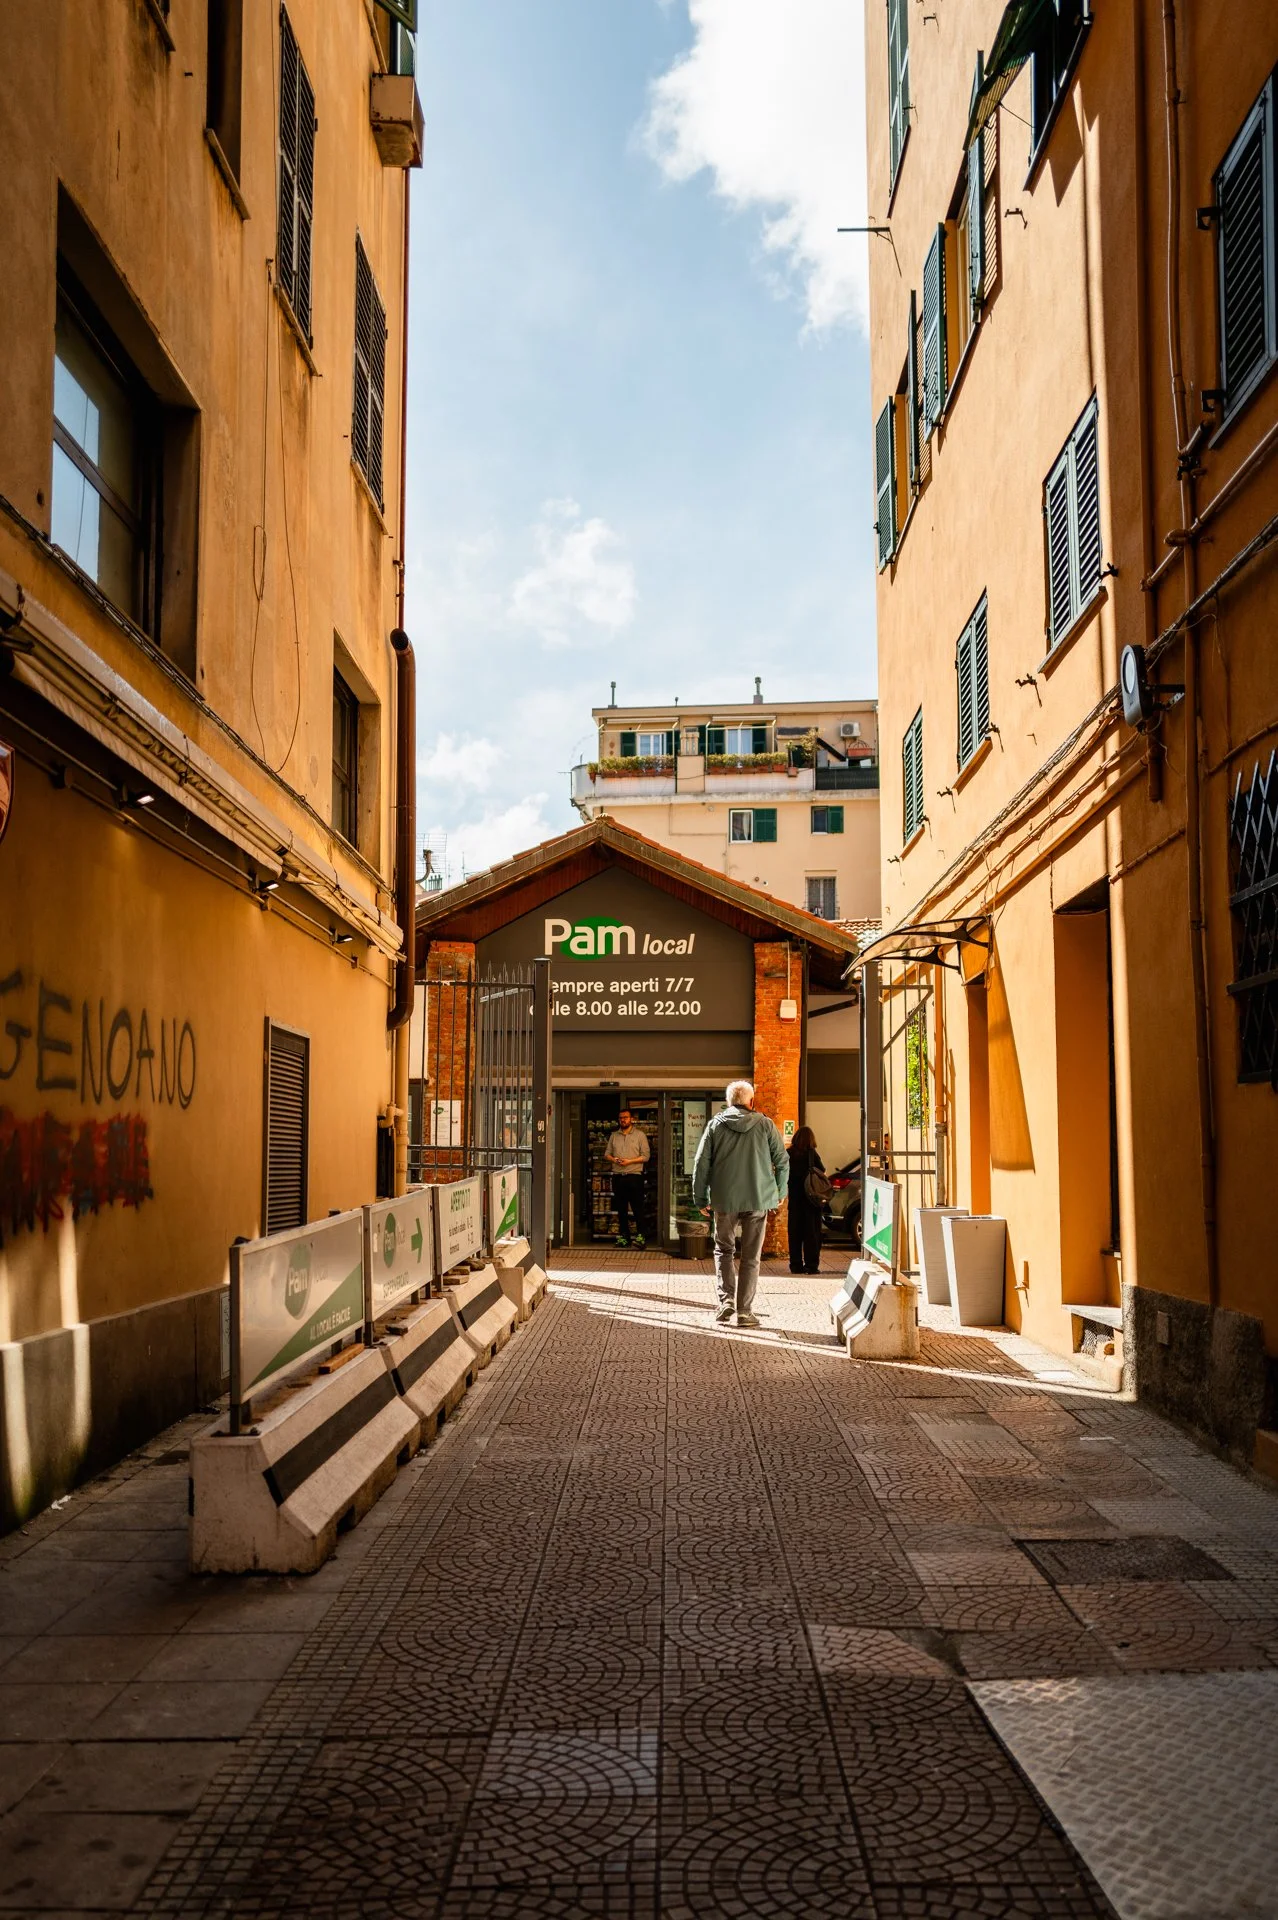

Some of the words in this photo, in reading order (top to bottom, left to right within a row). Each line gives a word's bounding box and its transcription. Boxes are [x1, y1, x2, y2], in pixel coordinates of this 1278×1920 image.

[544, 918, 636, 956] Pam
[642, 933, 695, 955] local
[551, 981, 604, 995] empre
[609, 978, 659, 995] aperti
[665, 977, 695, 992] 7/7
[576, 1001, 612, 1016] 8.00
[617, 1001, 648, 1016] alle
[654, 1001, 701, 1016] 22.00
[288, 1267, 308, 1296] Pam
